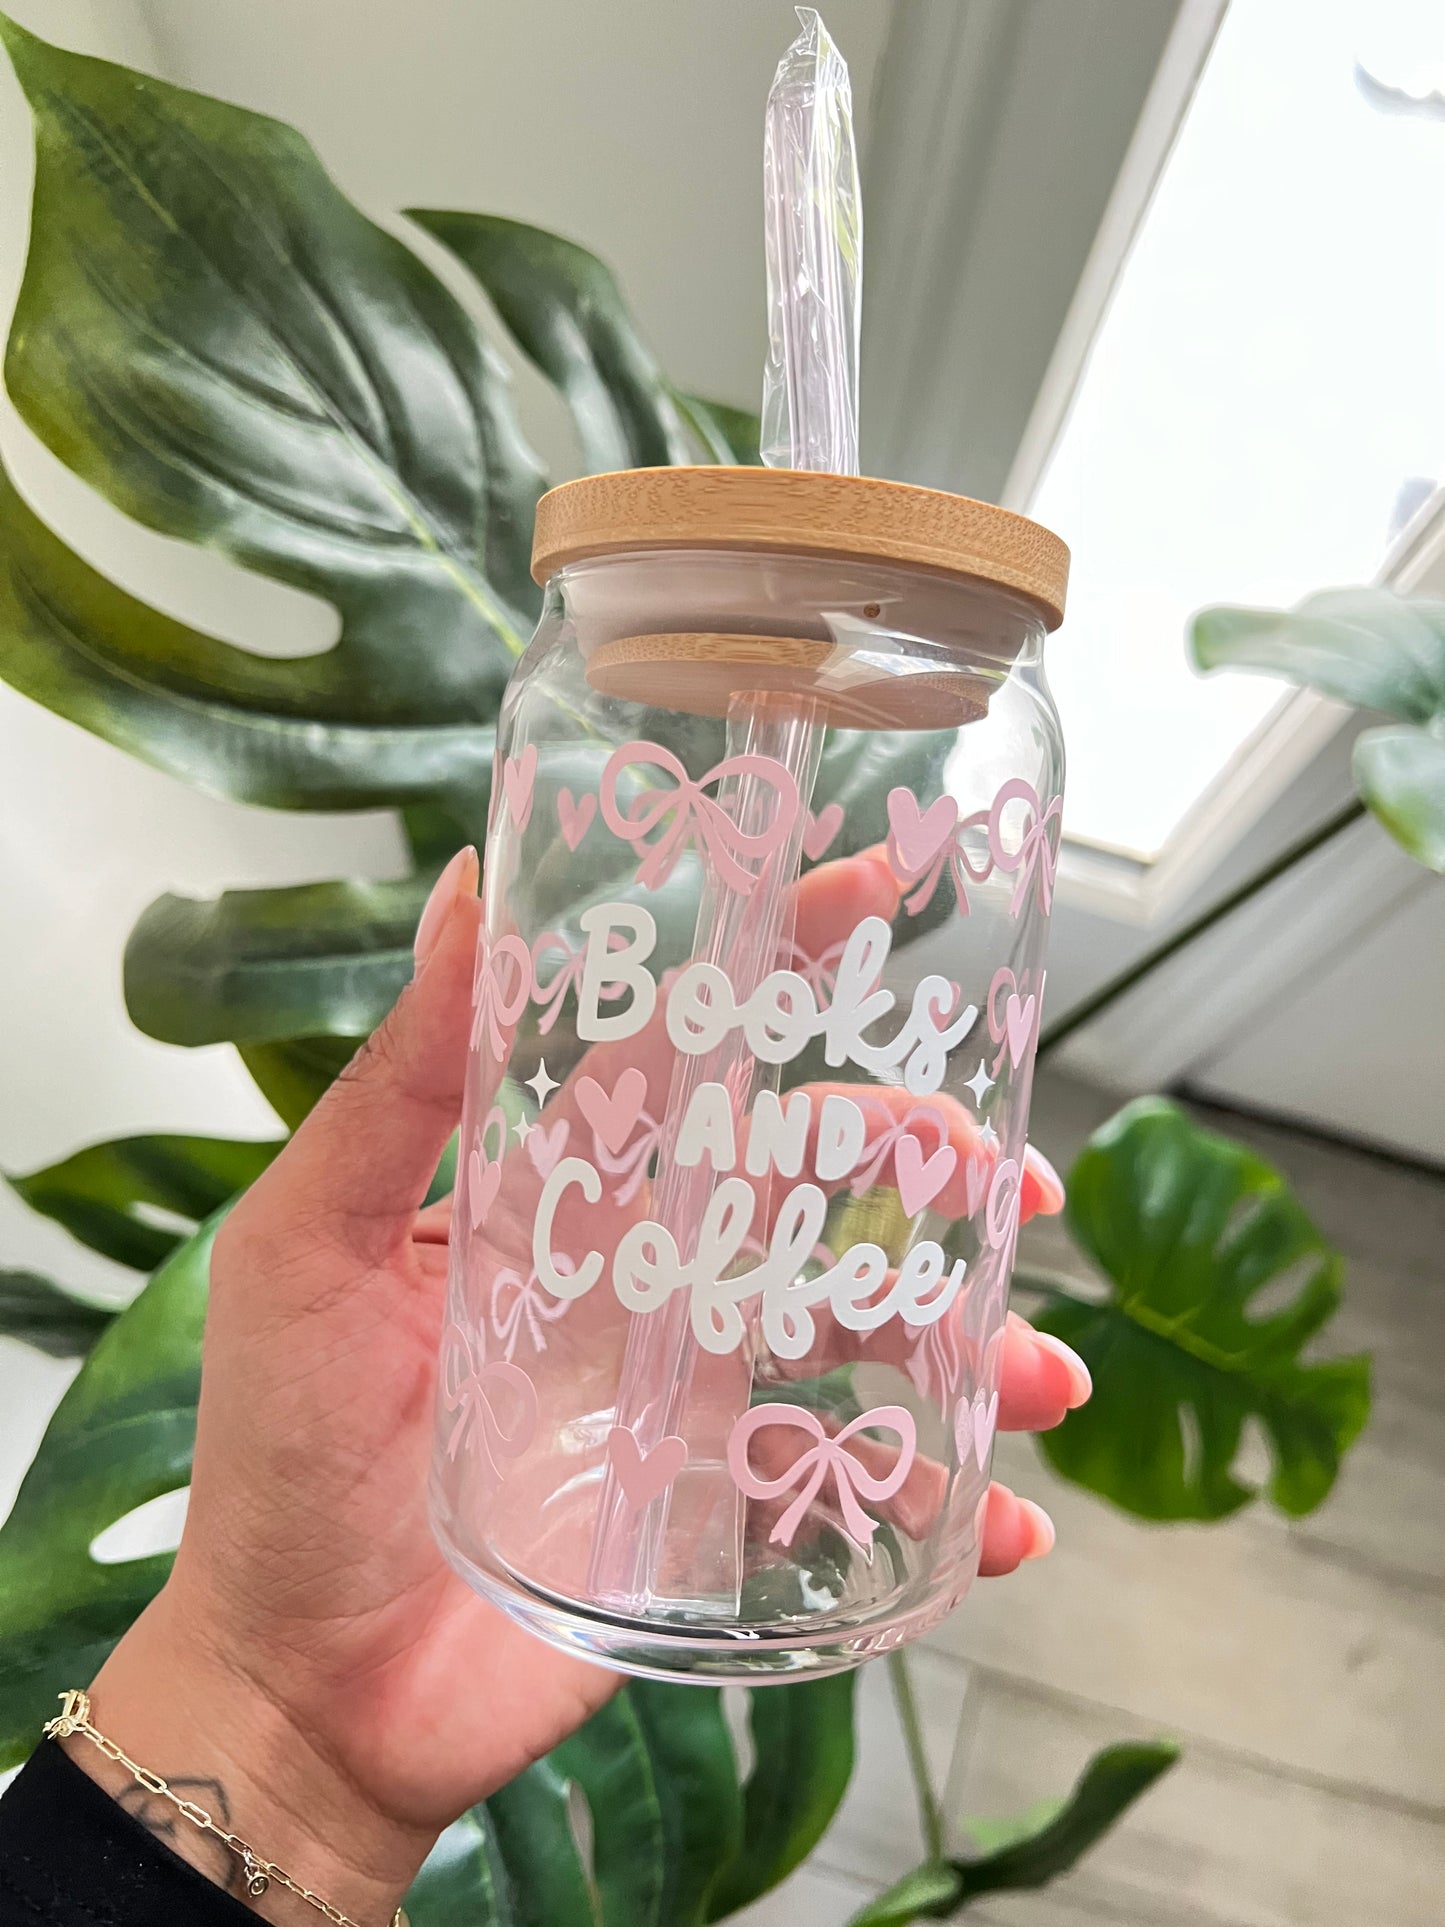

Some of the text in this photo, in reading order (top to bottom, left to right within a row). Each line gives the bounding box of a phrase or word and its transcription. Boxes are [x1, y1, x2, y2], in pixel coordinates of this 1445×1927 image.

[576, 902, 978, 1096] Books
[675, 1082, 866, 1181] AND
[532, 1156, 967, 1360] Coffee
